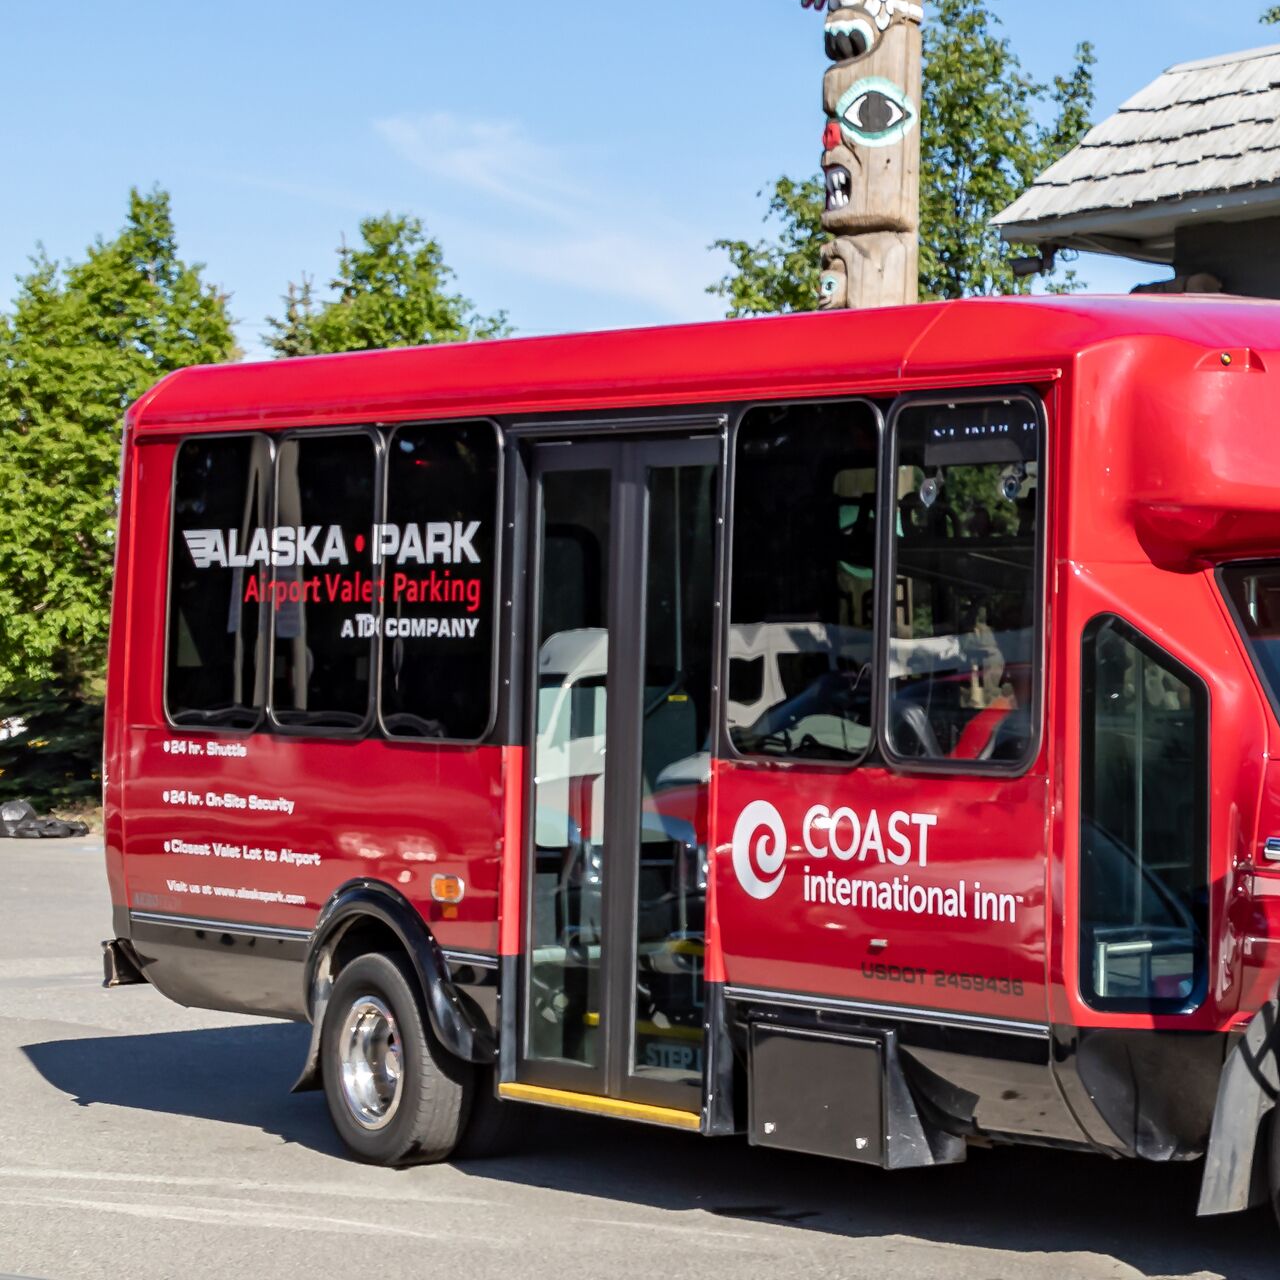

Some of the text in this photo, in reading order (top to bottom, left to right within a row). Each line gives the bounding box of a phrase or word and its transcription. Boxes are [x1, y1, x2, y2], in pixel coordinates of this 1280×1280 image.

[182, 521, 482, 569] ALASKA PARK
[244, 570, 481, 612] Airport Valet Parking
[340, 619, 355, 638] A
[384, 617, 480, 638] COMPANY
[171, 740, 247, 757] 24 hr. Shuttle
[170, 789, 295, 815] 24 hr. On-Site Security
[802, 804, 938, 867] COAST
[171, 839, 322, 867] Closest Valet Lot to Airport
[166, 879, 306, 905] Visit us at www.alaskapark.com
[803, 865, 967, 918] international
[861, 961, 1024, 997] USDOT 2459436
[646, 1042, 693, 1070] STEP
